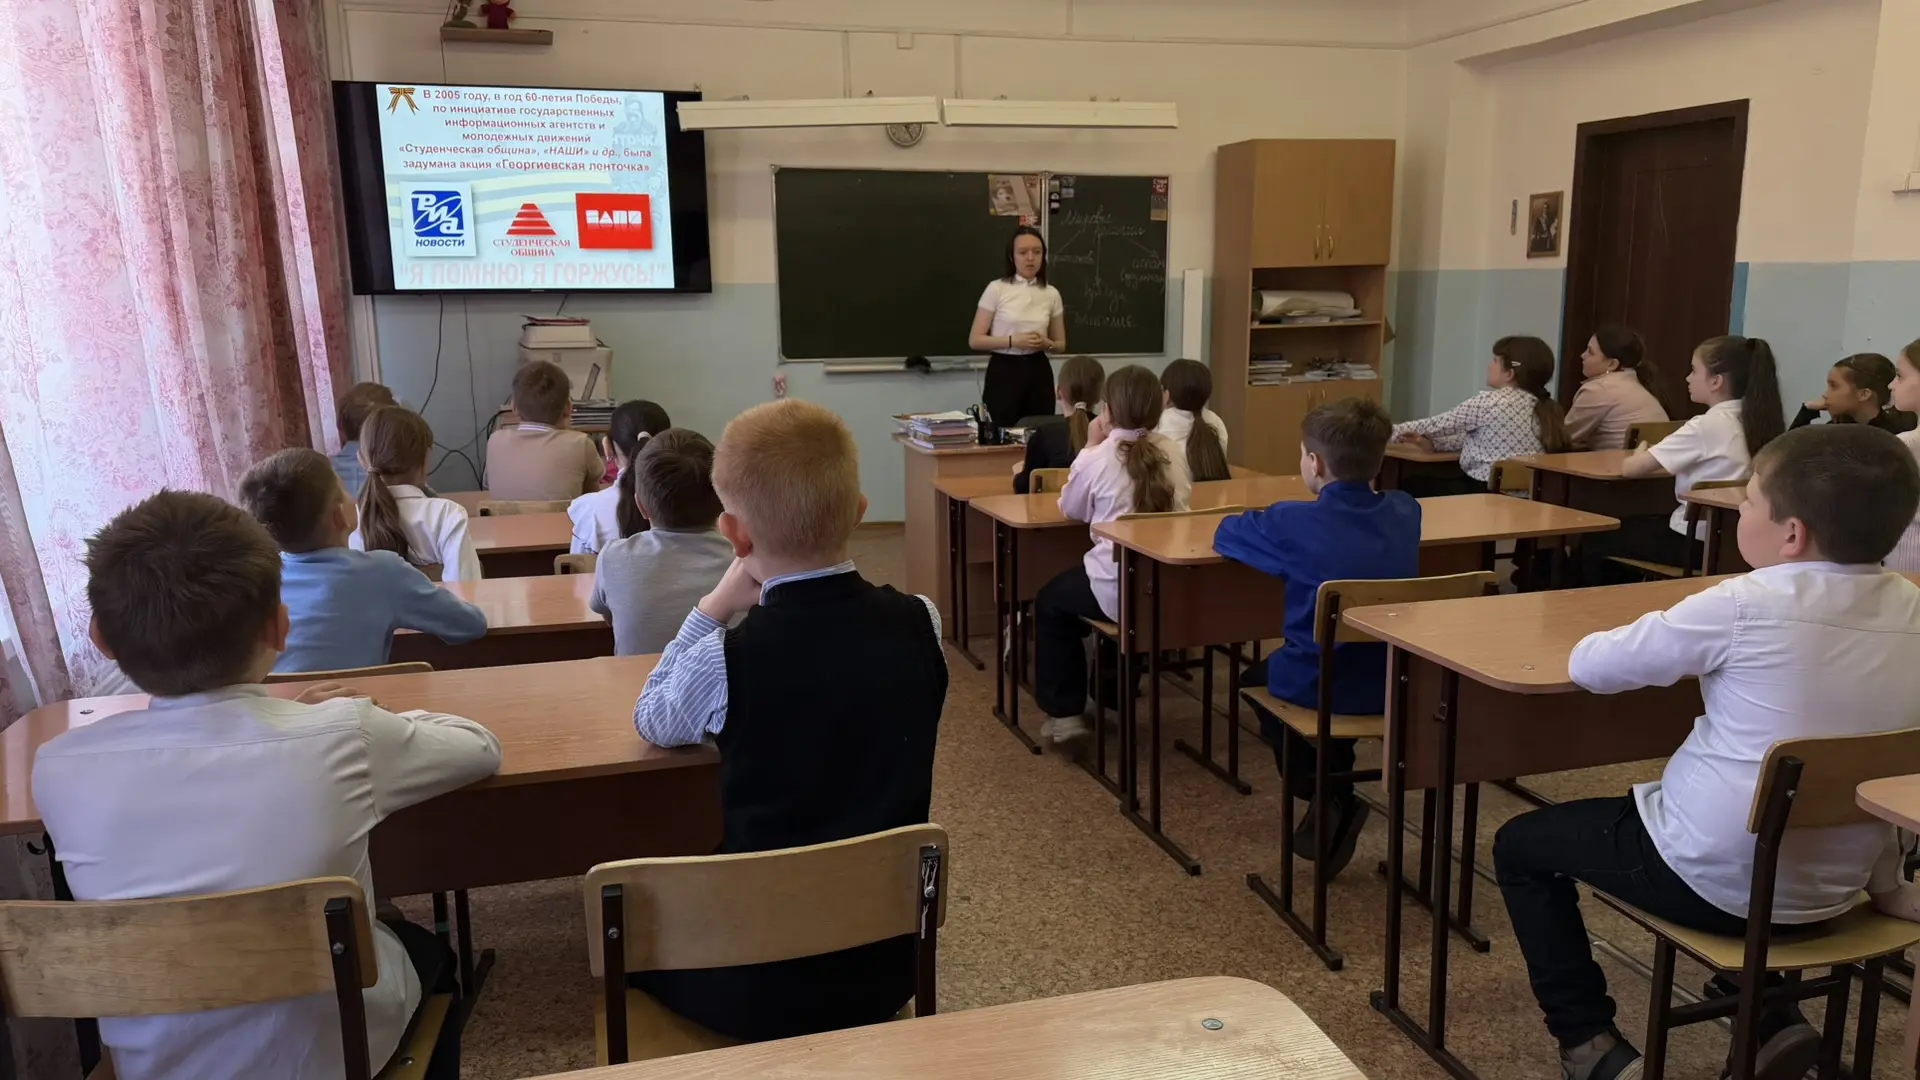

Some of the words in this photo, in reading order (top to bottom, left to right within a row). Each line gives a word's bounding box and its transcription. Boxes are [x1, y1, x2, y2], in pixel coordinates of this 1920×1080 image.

[424, 90, 431, 99] В
[435, 90, 460, 100] 2005
[463, 92, 490, 101] году,
[504, 94, 522, 102] год
[525, 92, 572, 103] 60-летия
[576, 94, 622, 105] Победы,
[433, 105, 446, 113] по
[450, 105, 516, 115] инициативе
[520, 107, 614, 118] государственных
[445, 118, 546, 129] информационных
[549, 121, 596, 130] агентств
[599, 122, 606, 130] и
[537, 134, 591, 144] движений
[399, 143, 483, 156] «Студенческая
[487, 144, 540, 156] община»,
[544, 146, 589, 156] «НАШИ»
[624, 148, 652, 158] была
[403, 160, 456, 171] задумана
[459, 161, 492, 170] акция
[496, 159, 586, 172] «Георгиевская
[589, 162, 650, 172] ленточка»
[415, 239, 465, 248] НОВОСТИ
[493, 239, 571, 248] СТУДЕНЧЕСКАЯ
[510, 248, 555, 257] ОБЩИНА
[431, 262, 526, 285] ПОМНЮ!
[532, 262, 546, 285] Я
